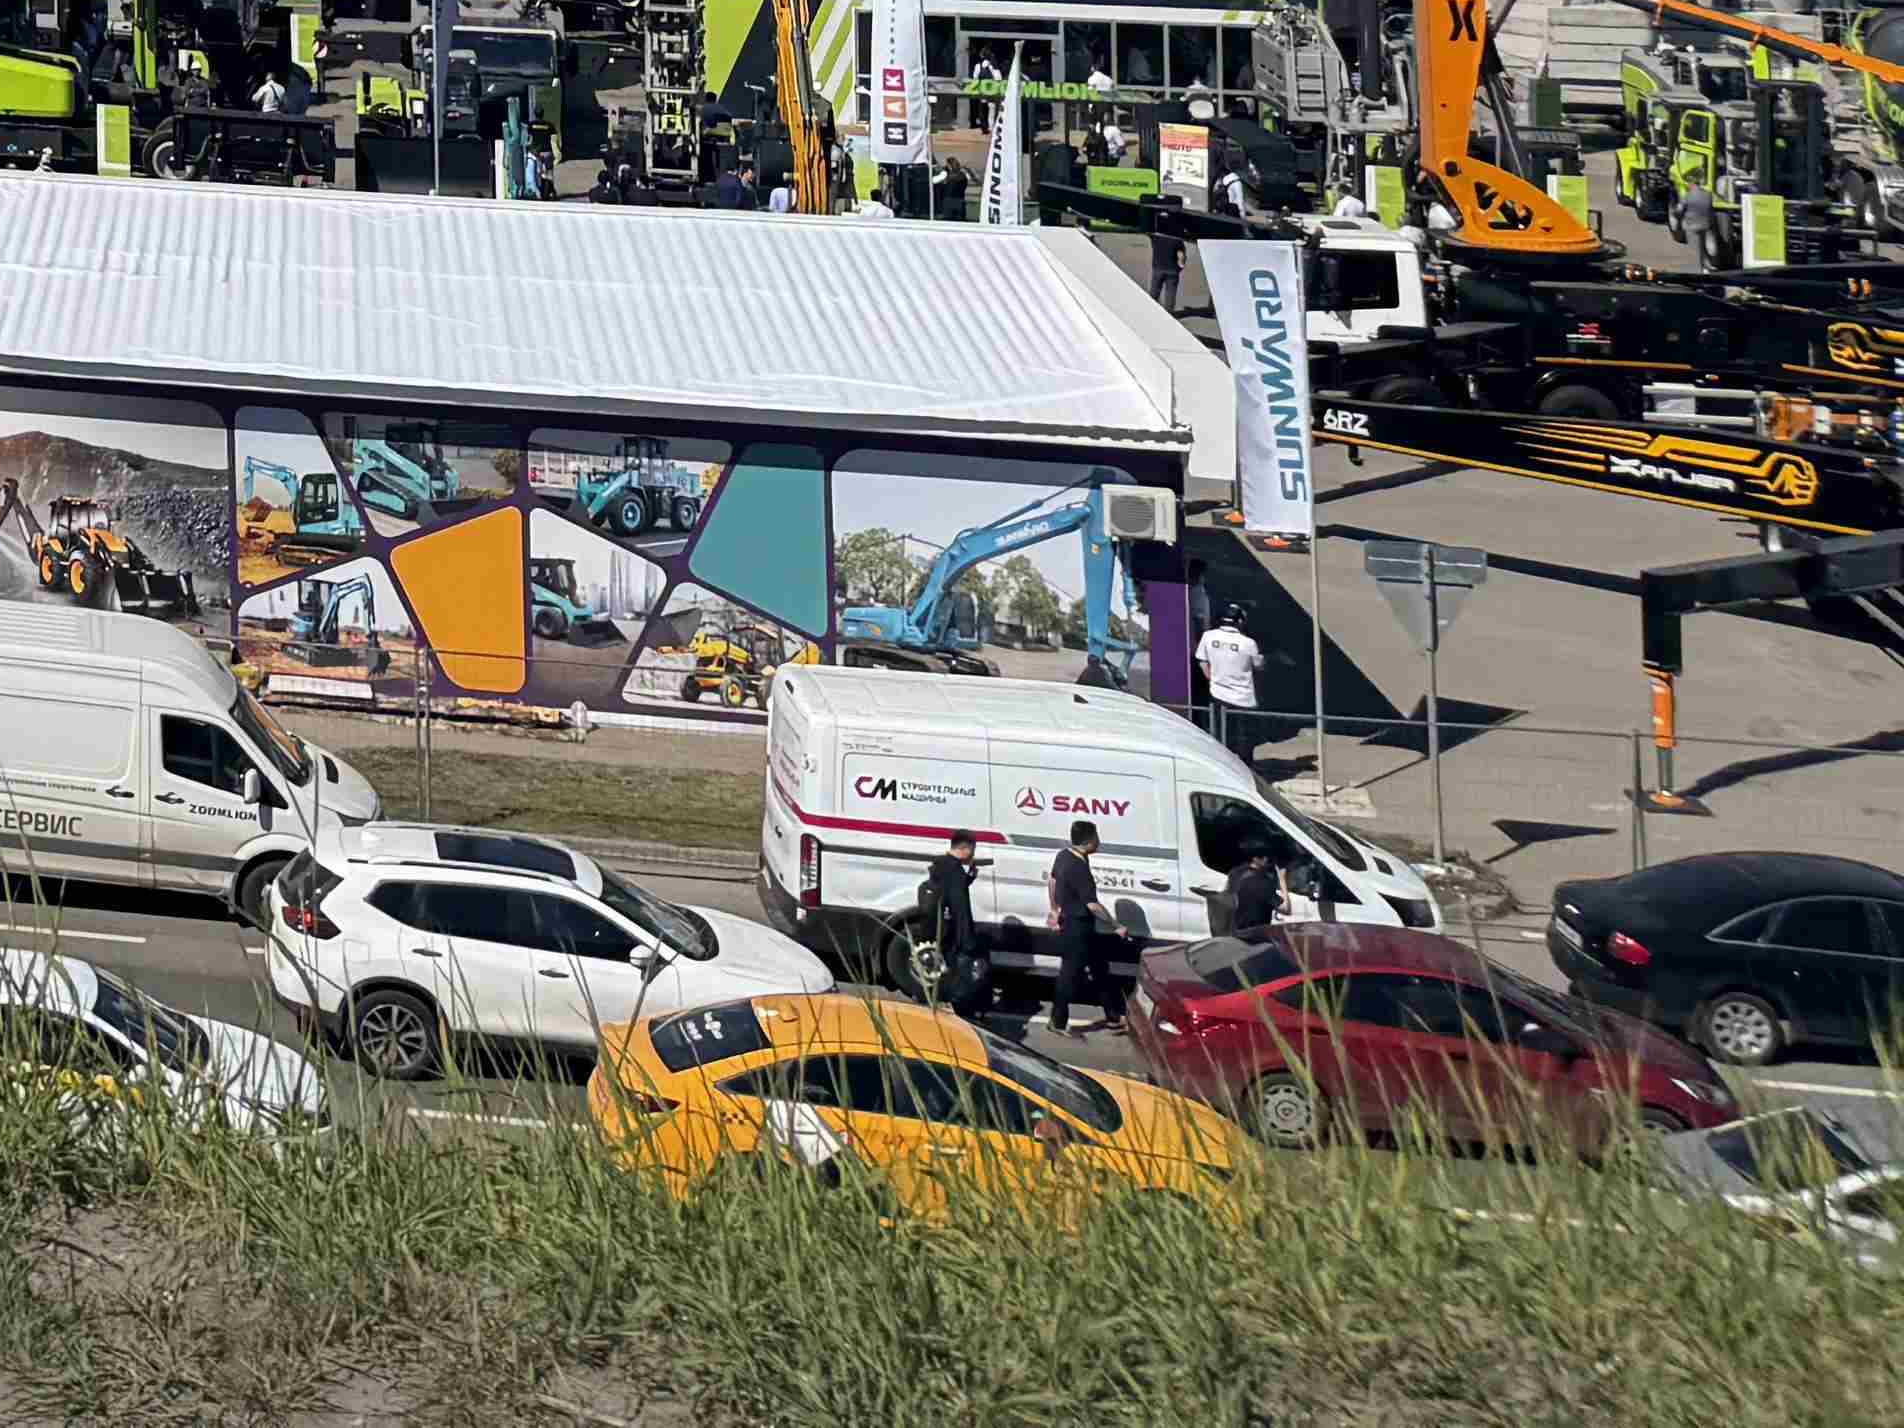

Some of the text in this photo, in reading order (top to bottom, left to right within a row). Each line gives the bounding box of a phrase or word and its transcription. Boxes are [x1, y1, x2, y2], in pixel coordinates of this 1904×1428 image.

[1241, 269, 1308, 503] SUNWARD
[189, 803, 258, 822] ZOOMLION
[1051, 795, 1131, 818] SANY
